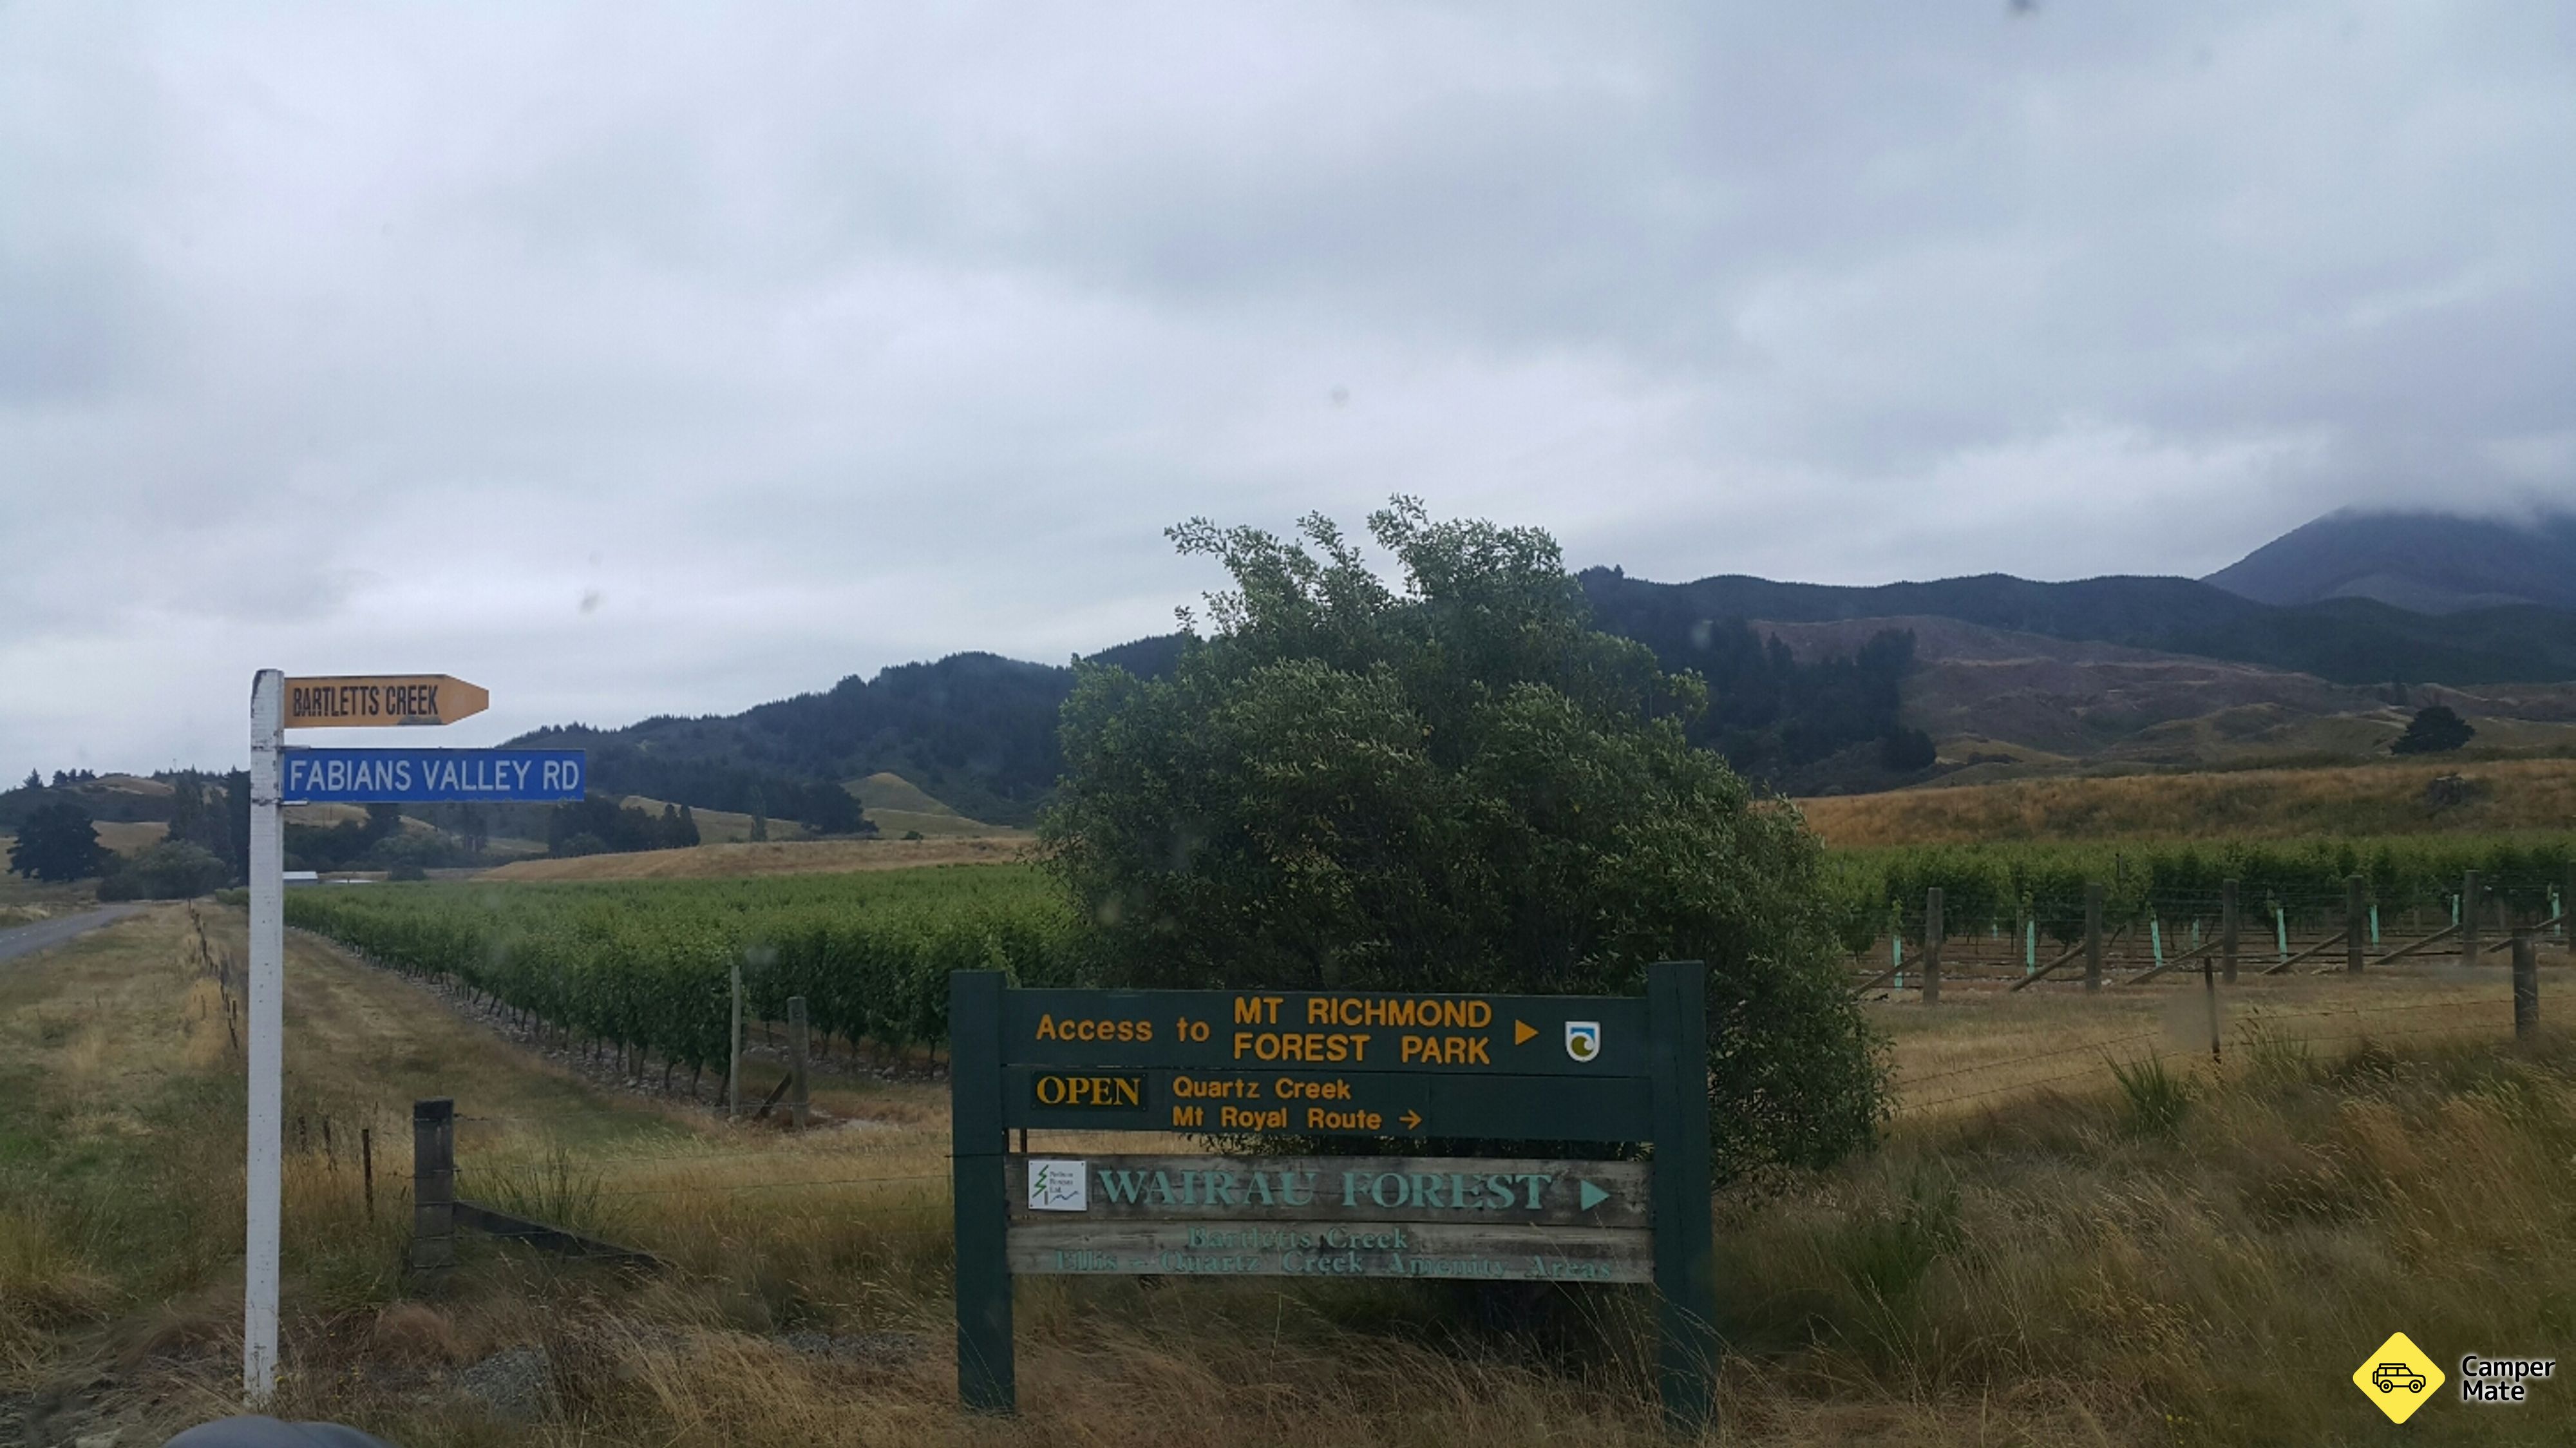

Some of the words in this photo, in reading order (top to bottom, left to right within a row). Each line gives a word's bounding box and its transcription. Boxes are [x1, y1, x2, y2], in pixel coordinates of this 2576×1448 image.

[293, 686, 379, 716] BARTLETTS
[386, 685, 439, 716] CREEK
[290, 759, 412, 791] FABIANS
[422, 760, 532, 790] VALLEY
[542, 759, 579, 790] RD
[1036, 1014, 1153, 1042] Access
[1177, 1017, 1209, 1042] to
[1235, 997, 1283, 1024] MT
[1308, 998, 1492, 1029] RICHMOND
[1234, 1033, 1370, 1062] FOREST
[1402, 1036, 1491, 1065] PARK
[1036, 1076, 1141, 1106] OPEN
[1173, 1077, 1260, 1099] Quartz
[1274, 1078, 1351, 1100] Creek
[1173, 1106, 1204, 1127] Mt
[1222, 1106, 1287, 1131] Royal
[1308, 1109, 1382, 1130] Route
[1098, 1170, 1317, 1206] WAIRAU
[1342, 1172, 1551, 1210] FOREST
[1327, 1227, 1408, 1249] Creek
[1161, 1250, 1260, 1273] Quartz
[1283, 1250, 1364, 1273] Creek
[1526, 1255, 1611, 1279] Areas
